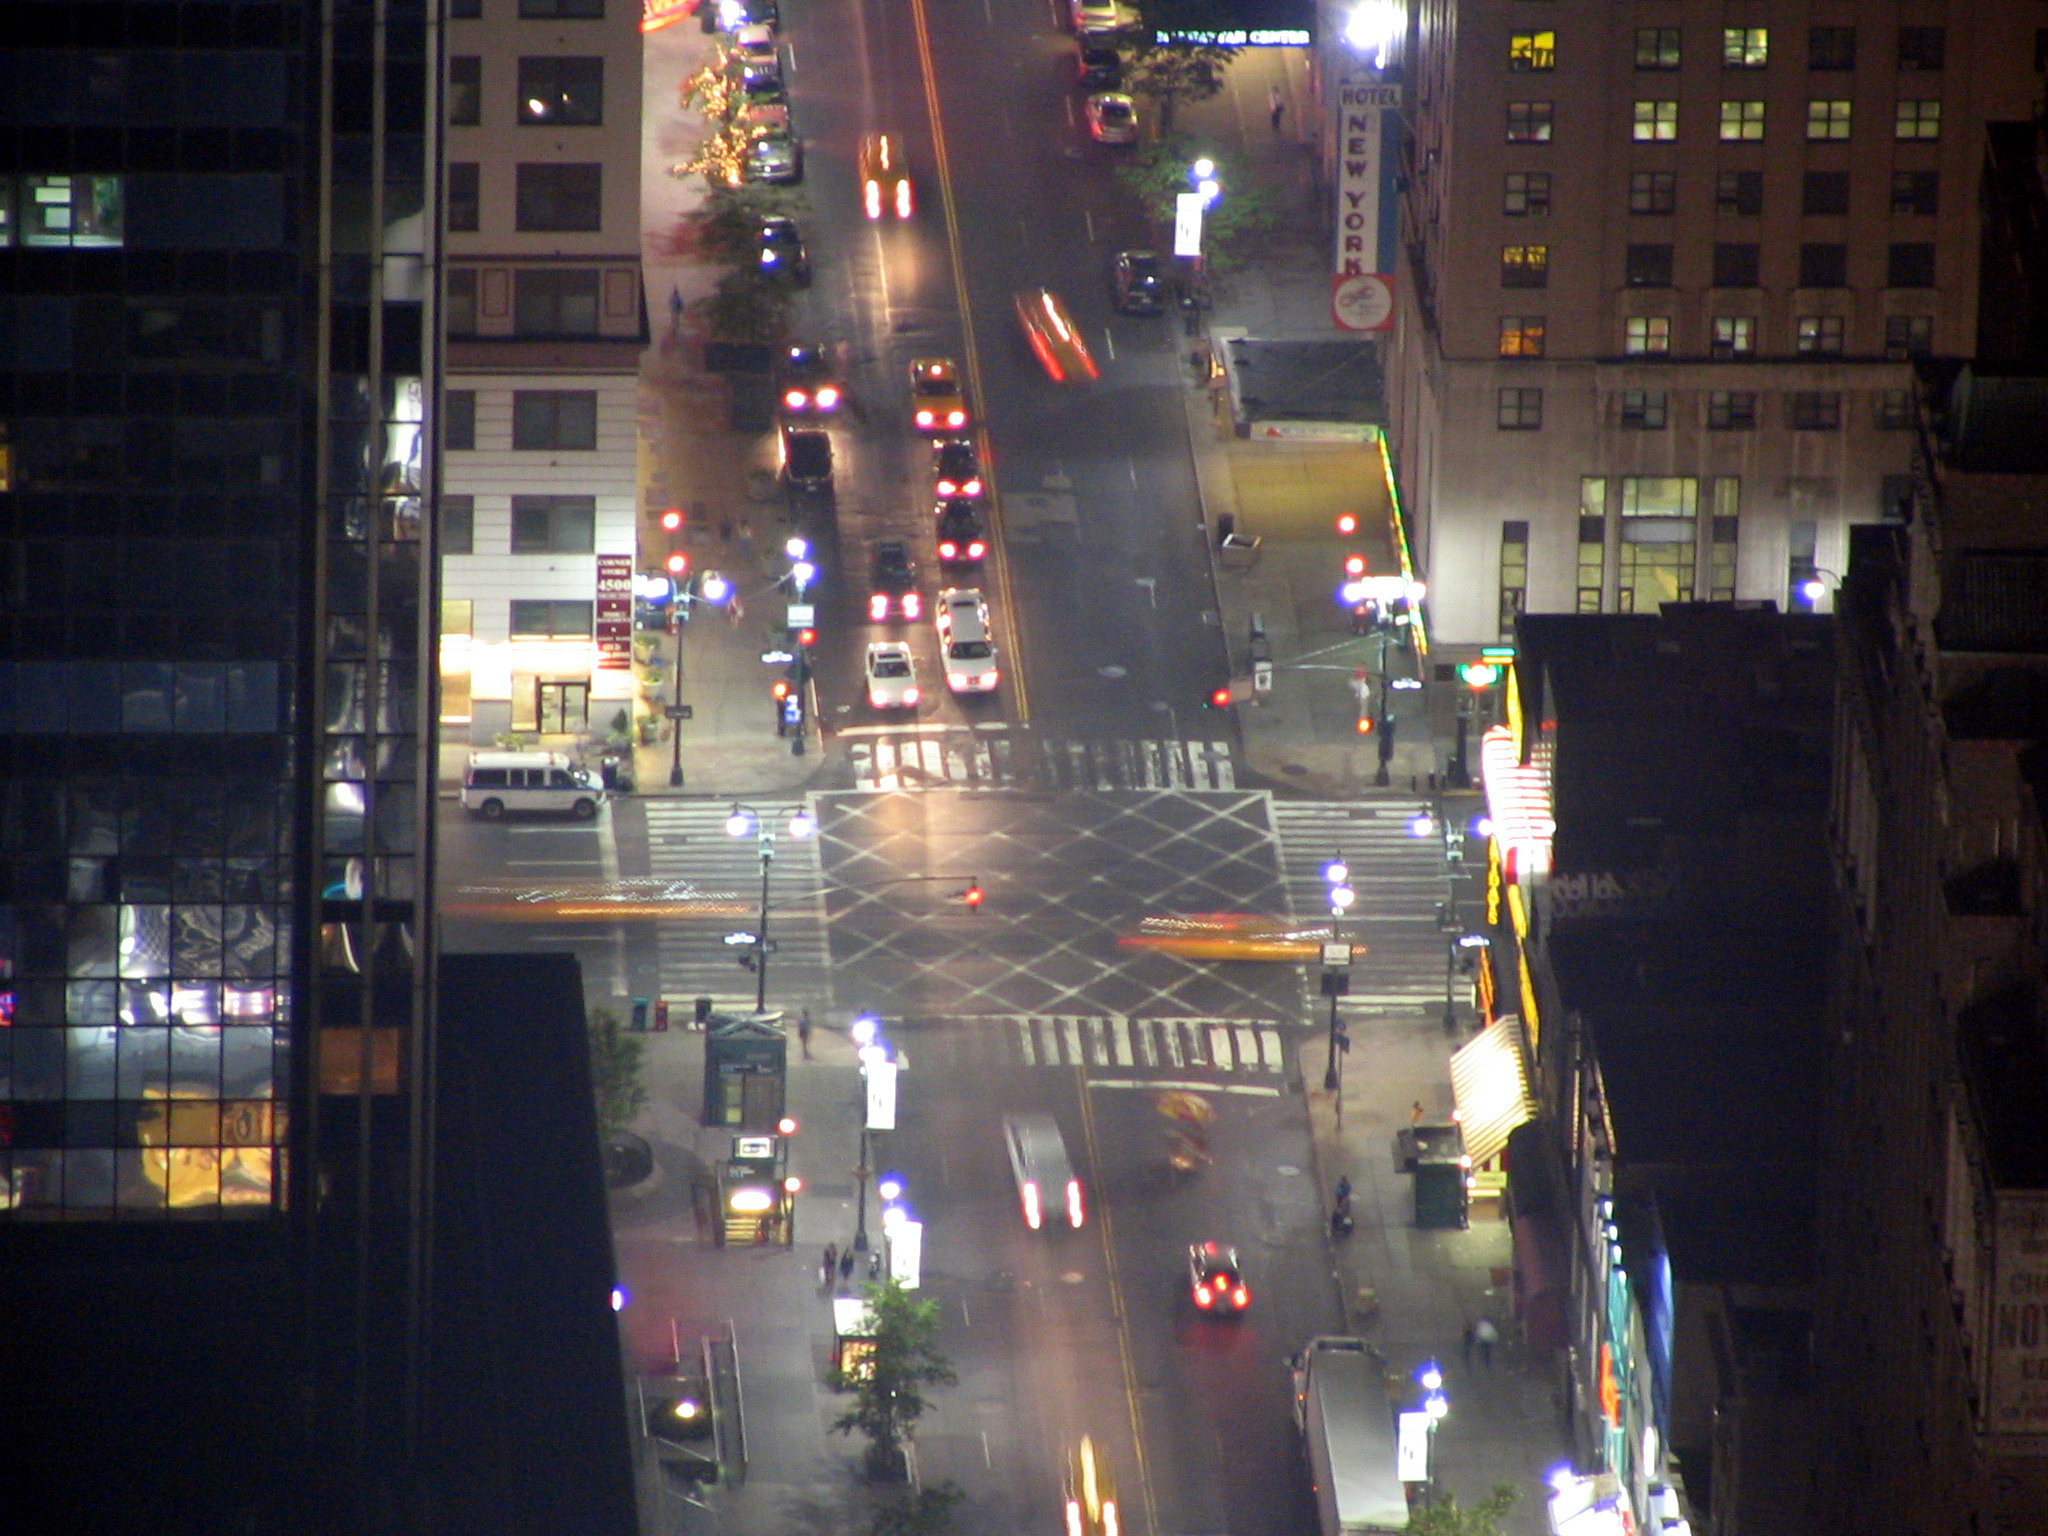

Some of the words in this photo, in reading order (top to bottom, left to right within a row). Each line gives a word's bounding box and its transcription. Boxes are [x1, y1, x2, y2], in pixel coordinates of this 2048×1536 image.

[1251, 29, 1311, 44] CENTER
[1343, 88, 1397, 105] HOTEL
[1345, 113, 1367, 177] NEW
[1345, 190, 1366, 275] YORK
[598, 579, 631, 592] 4500
